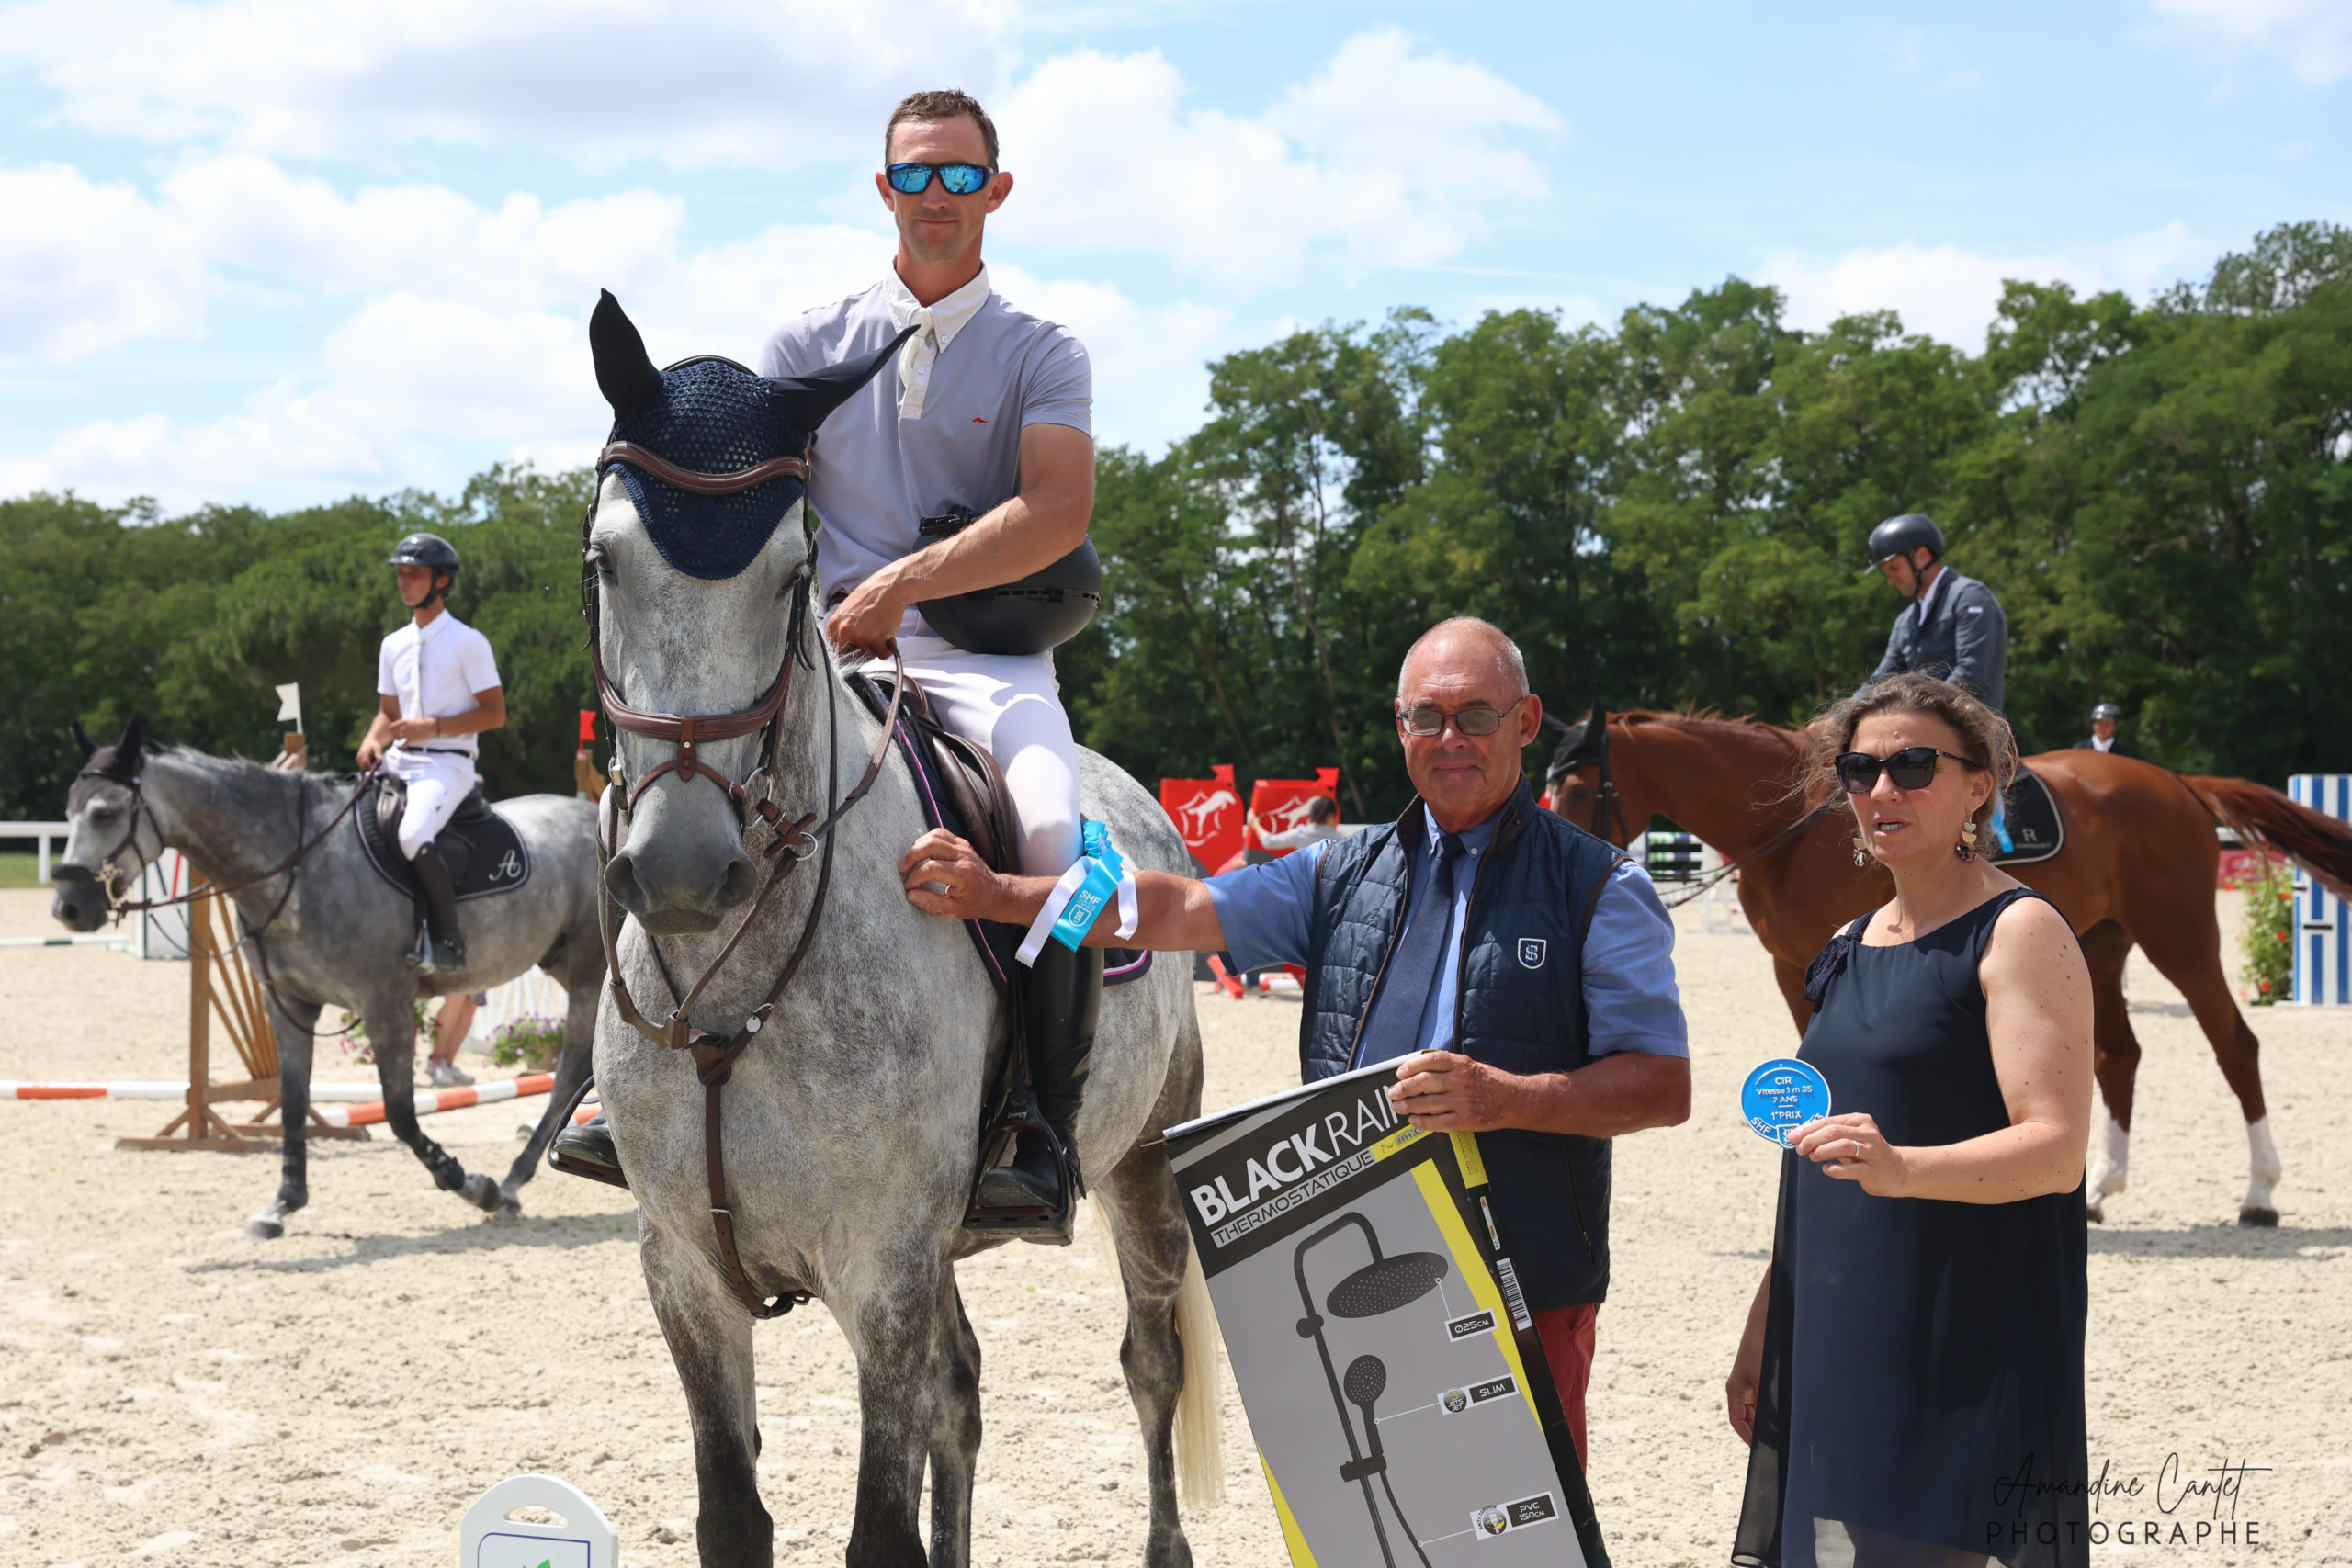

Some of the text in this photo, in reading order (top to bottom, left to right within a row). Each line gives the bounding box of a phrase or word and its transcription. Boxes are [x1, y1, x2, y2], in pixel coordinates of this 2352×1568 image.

[1080, 890, 1102, 904] SHF
[1774, 1077, 1792, 1085] CIR
[1780, 1095, 1798, 1103] ANS
[1750, 1117, 1772, 1134] SHF
[1213, 1149, 1374, 1245] THERMOSTATIQUE
[1479, 1383, 1506, 1397] SLIM
[1520, 1502, 1540, 1513] PVC
